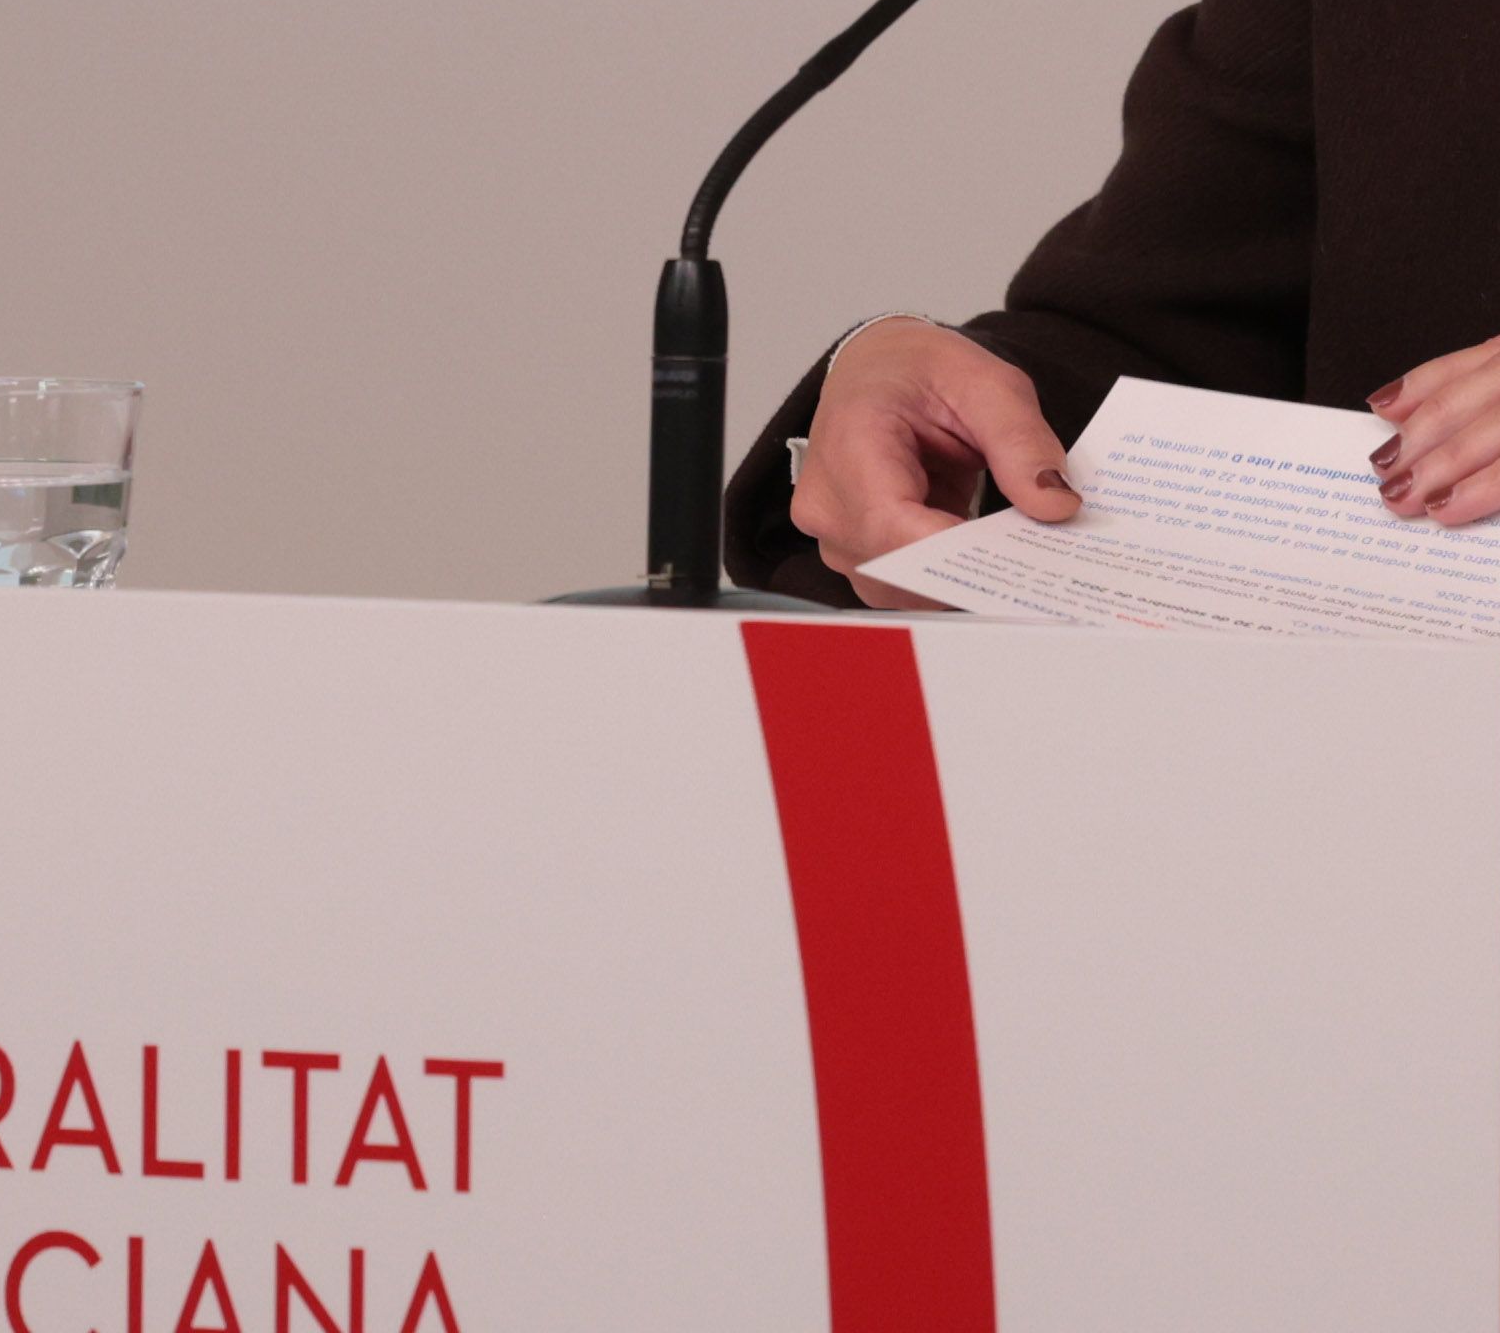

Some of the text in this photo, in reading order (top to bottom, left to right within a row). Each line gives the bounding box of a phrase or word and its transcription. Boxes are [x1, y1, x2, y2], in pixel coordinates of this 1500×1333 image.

[1120, 434, 1145, 444] por
[1150, 437, 1205, 455] contrato,
[1108, 452, 1125, 461] de
[1208, 449, 1229, 460] del
[1231, 454, 1244, 463] D
[1128, 455, 1196, 474] noviembre
[1247, 456, 1275, 469] lote
[1277, 461, 1293, 471] al
[1199, 468, 1216, 478] de
[1218, 471, 1237, 482] 22
[1297, 463, 1387, 487] espondiente
[1239, 475, 1256, 485] de
[1081, 485, 1098, 493] en
[1204, 489, 1222, 497] en
[1259, 479, 1329, 499] Resolución
[1102, 488, 1180, 509] helicópteros
[1224, 492, 1303, 513] helicópteros
[1082, 500, 1149, 520] dividiéndo
[1185, 503, 1208, 514] dos
[1211, 508, 1229, 517] de
[1305, 507, 1329, 517] dos
[1155, 513, 1192, 527] 2023,
[1232, 512, 1289, 528] servicios
[1331, 510, 1341, 519] y
[1194, 522, 1212, 530] de
[1293, 523, 1312, 534] los
[1346, 513, 1430, 535] emergencias,
[1215, 526, 1280, 543] principios
[1433, 528, 1442, 537] y
[1043, 535, 1074, 546] para
[1085, 534, 1120, 546] estos
[1281, 538, 1291, 546] a
[1361, 536, 1374, 545] D
[1377, 539, 1403, 551] lote
[1076, 544, 1123, 558] peligro
[1123, 542, 1141, 550] de
[1293, 541, 1329, 553] inició
[1404, 544, 1420, 554] El
[1145, 548, 1225, 567] contratación
[1332, 548, 1349, 556] se
[1426, 547, 1460, 561] lotes.
[1125, 556, 1164, 567] grave
[1352, 552, 1411, 568] ordinario
[1166, 564, 1184, 572] de
[1228, 564, 1246, 572] de
[1187, 569, 1261, 588] situaciones
[1250, 568, 1322, 587] expediente
[1415, 564, 1497, 584] contratación
[1176, 579, 1254, 599] continuidad
[1276, 588, 1317, 601] frente
[1321, 597, 1358, 609] hacer
[1388, 596, 1405, 604] se
[1274, 600, 1342, 617] garantizar
[1362, 606, 1424, 621] permitan
[1408, 600, 1467, 617] mientras
[1345, 615, 1406, 631] pretende
[1426, 618, 1452, 627] que
[1471, 613, 1495, 622] ello
